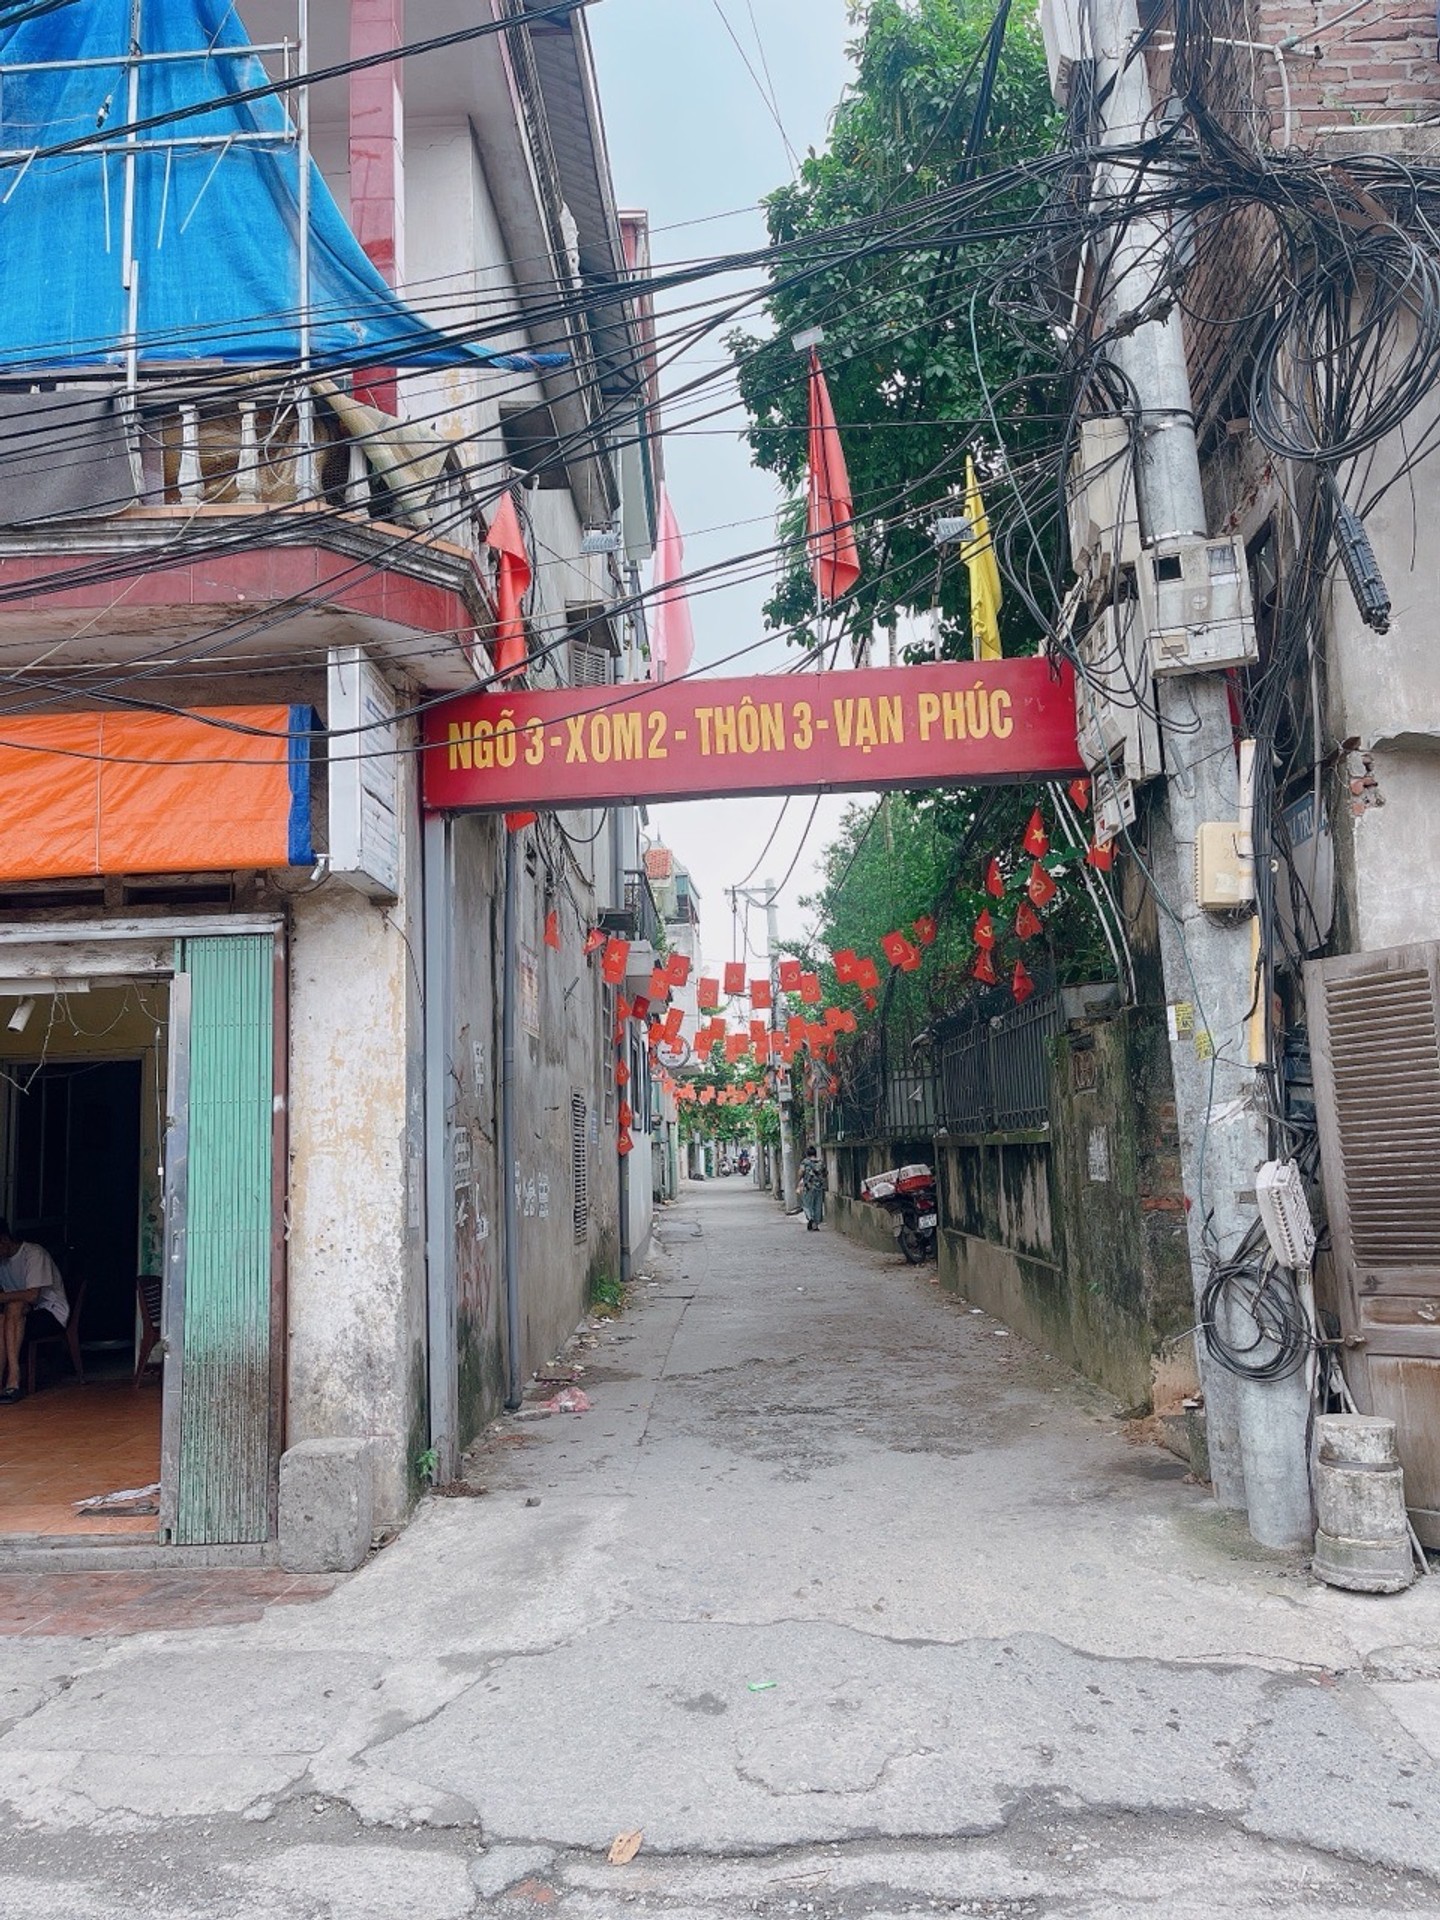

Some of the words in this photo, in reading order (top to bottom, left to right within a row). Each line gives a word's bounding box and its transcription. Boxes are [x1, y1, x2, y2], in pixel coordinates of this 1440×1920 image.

[450, 709, 516, 770] NGÕ
[695, 696, 786, 755] THÔN
[918, 680, 1013, 741] PHÚC
